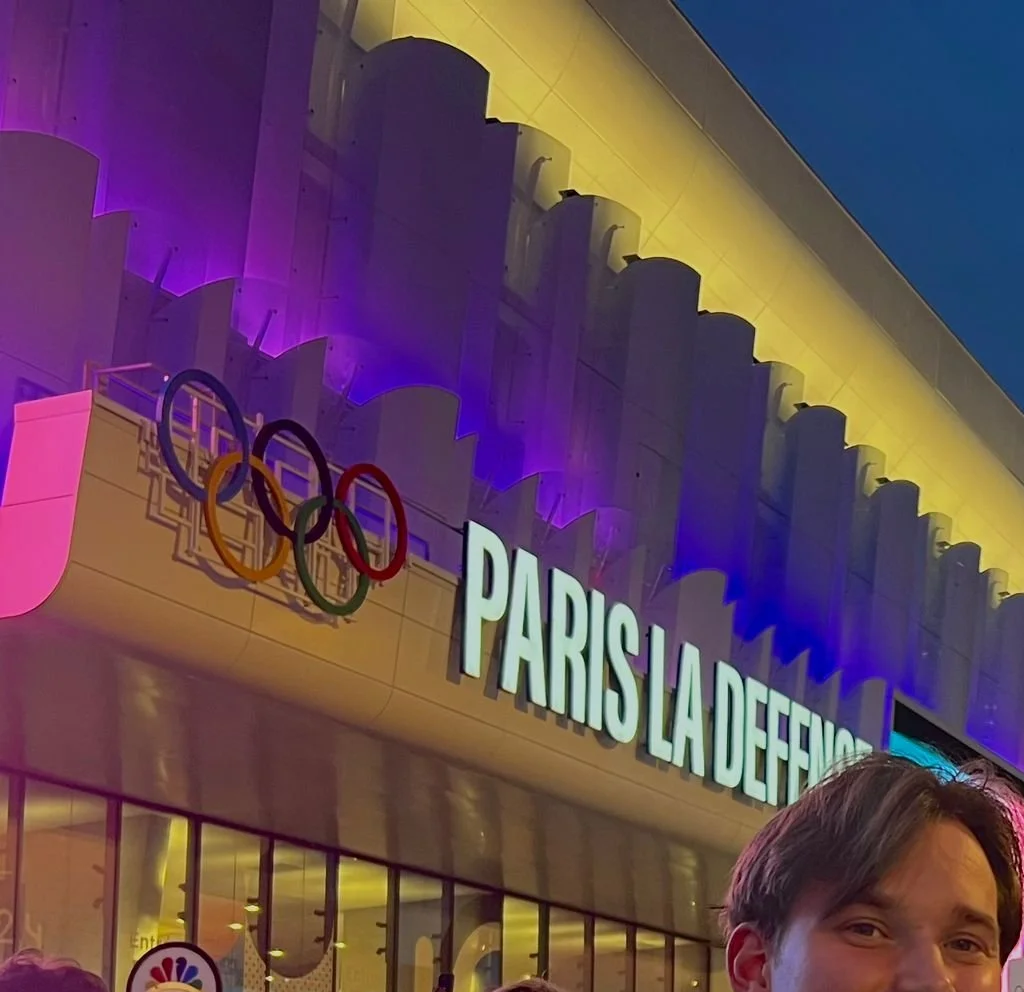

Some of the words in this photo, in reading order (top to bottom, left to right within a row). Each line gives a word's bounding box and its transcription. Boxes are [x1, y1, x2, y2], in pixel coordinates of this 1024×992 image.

[462, 520, 639, 744] PARIS
[648, 624, 706, 777] LA
[714, 660, 873, 807] DEFEN
